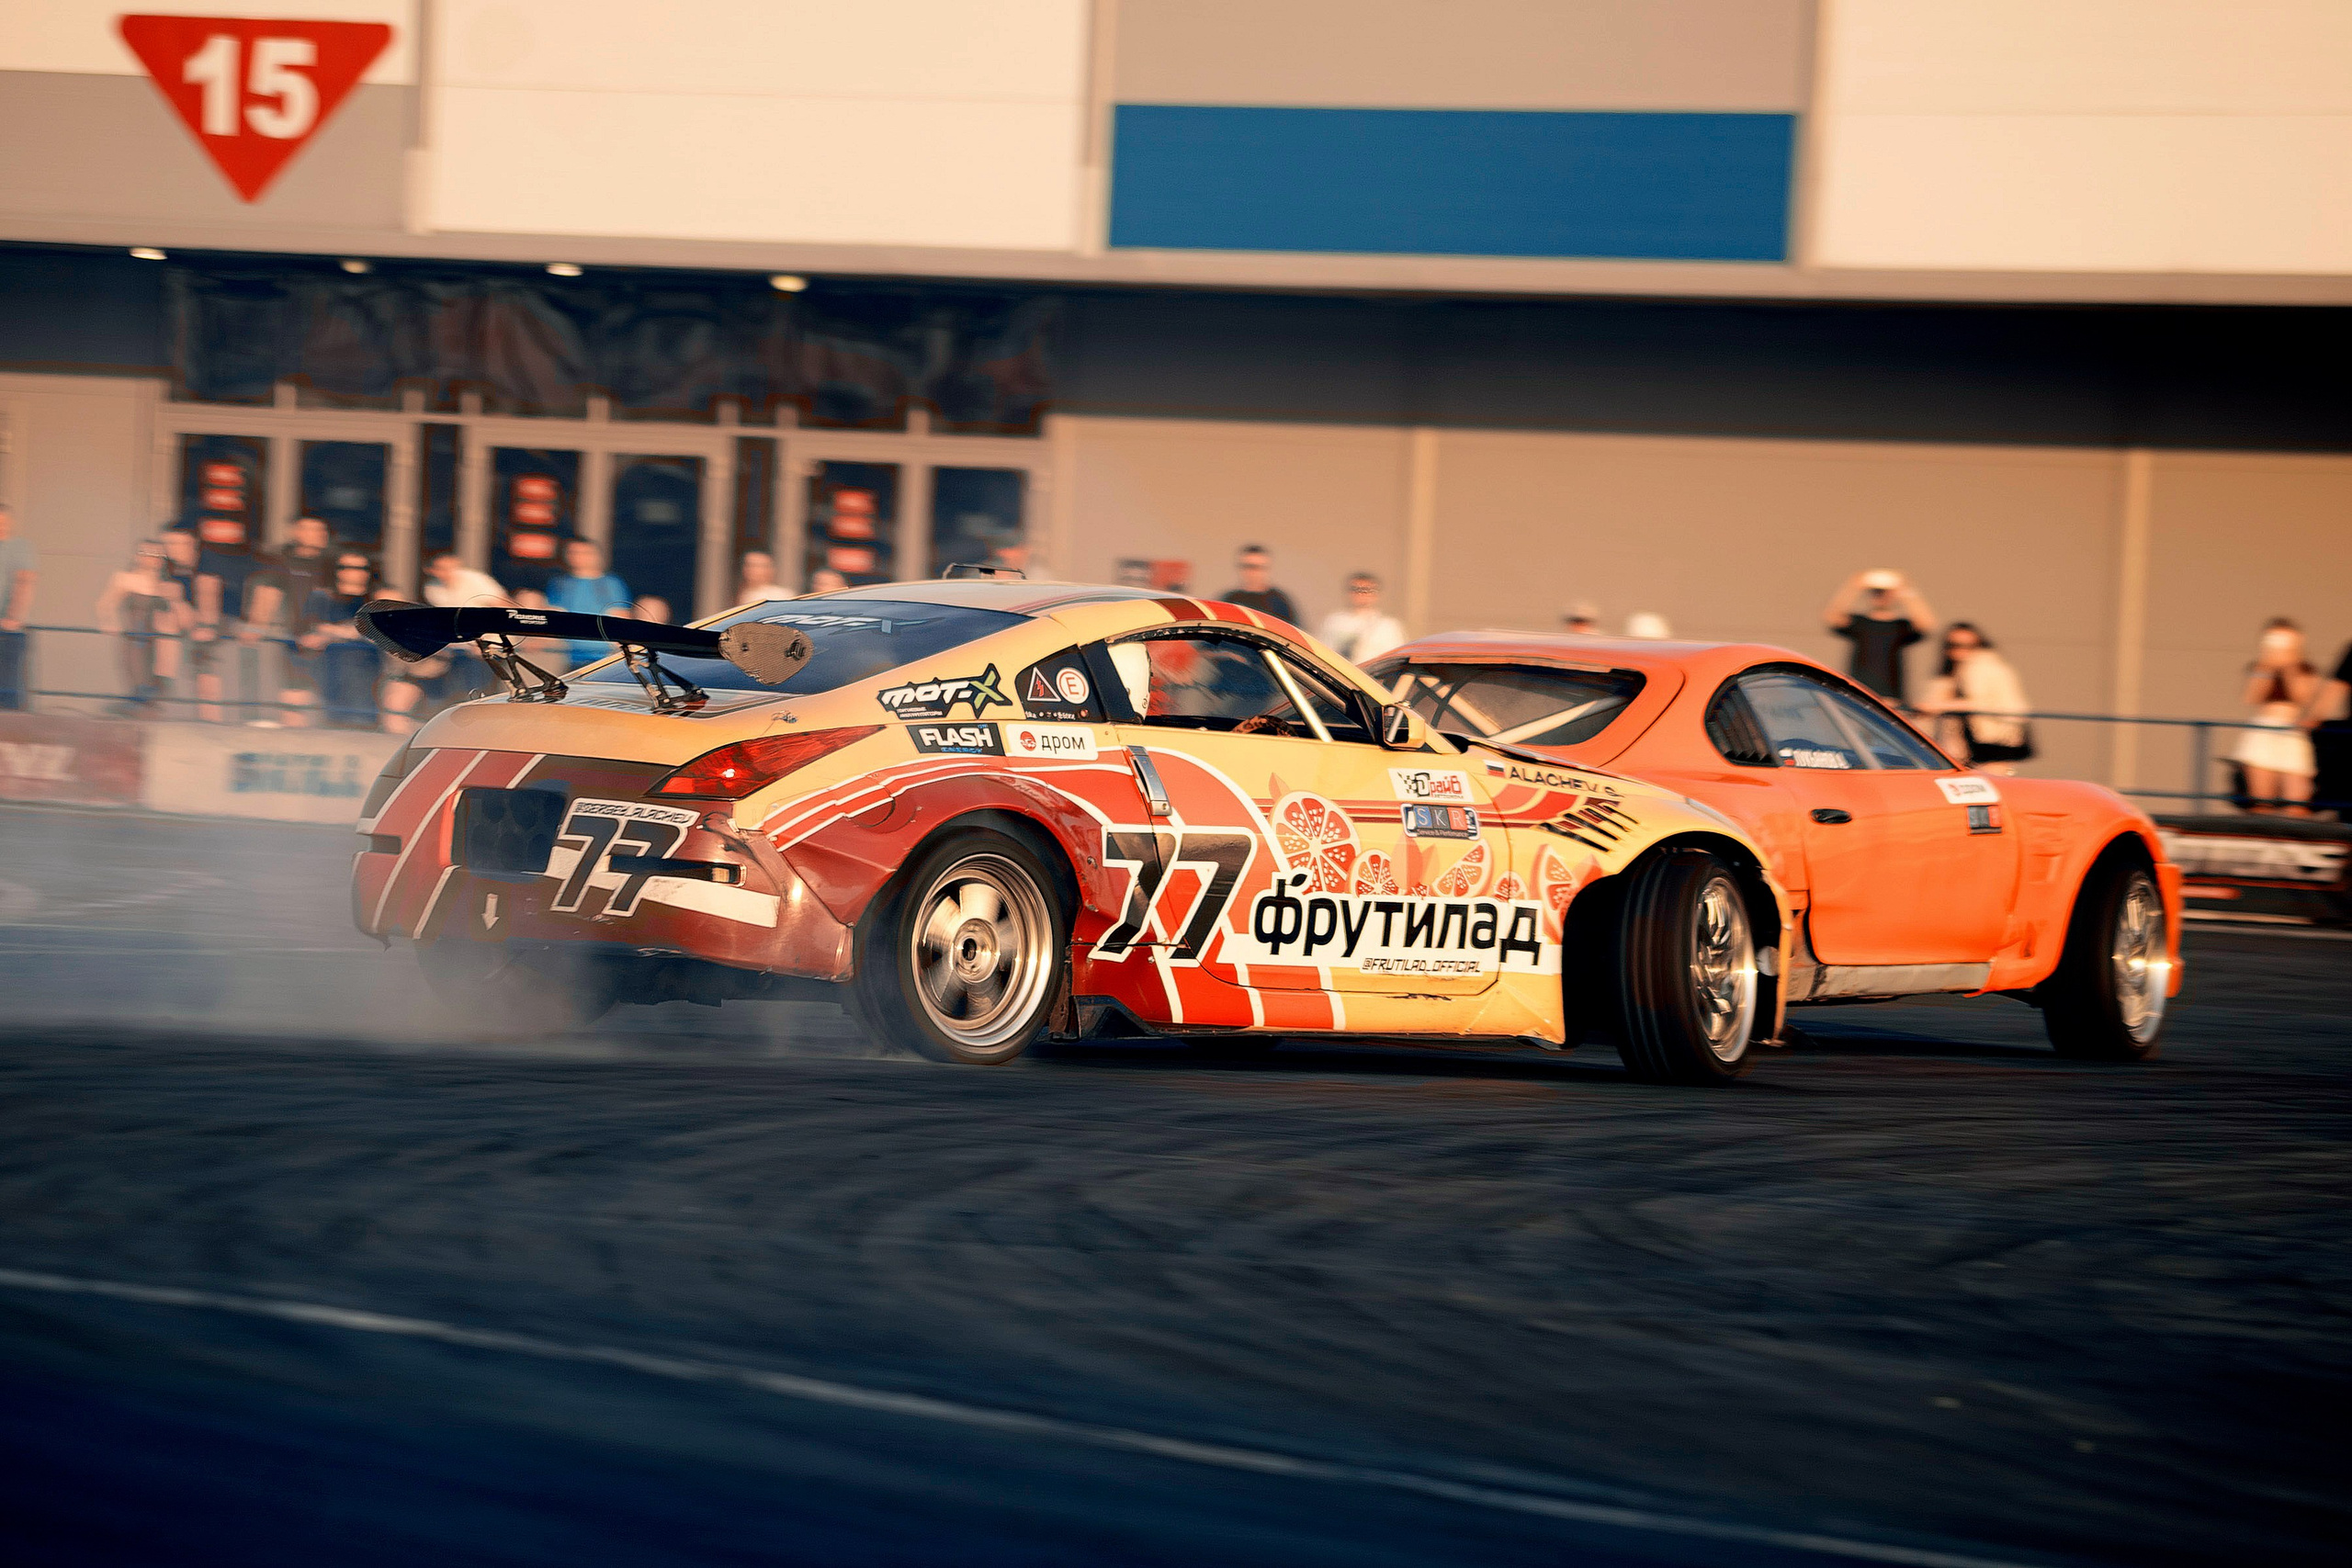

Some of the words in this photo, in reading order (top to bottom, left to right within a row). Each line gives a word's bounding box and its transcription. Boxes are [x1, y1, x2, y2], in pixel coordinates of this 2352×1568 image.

[183, 33, 320, 139] 15
[1066, 677, 1080, 694] E
[919, 728, 994, 747] FLASH
[1510, 766, 1597, 792] ALACHEV
[1416, 808, 1465, 828] SKR
[554, 814, 684, 915] 77
[1093, 829, 1255, 964] 77
[1362, 957, 1482, 973] @FRUTILAD_OFFICIAL
